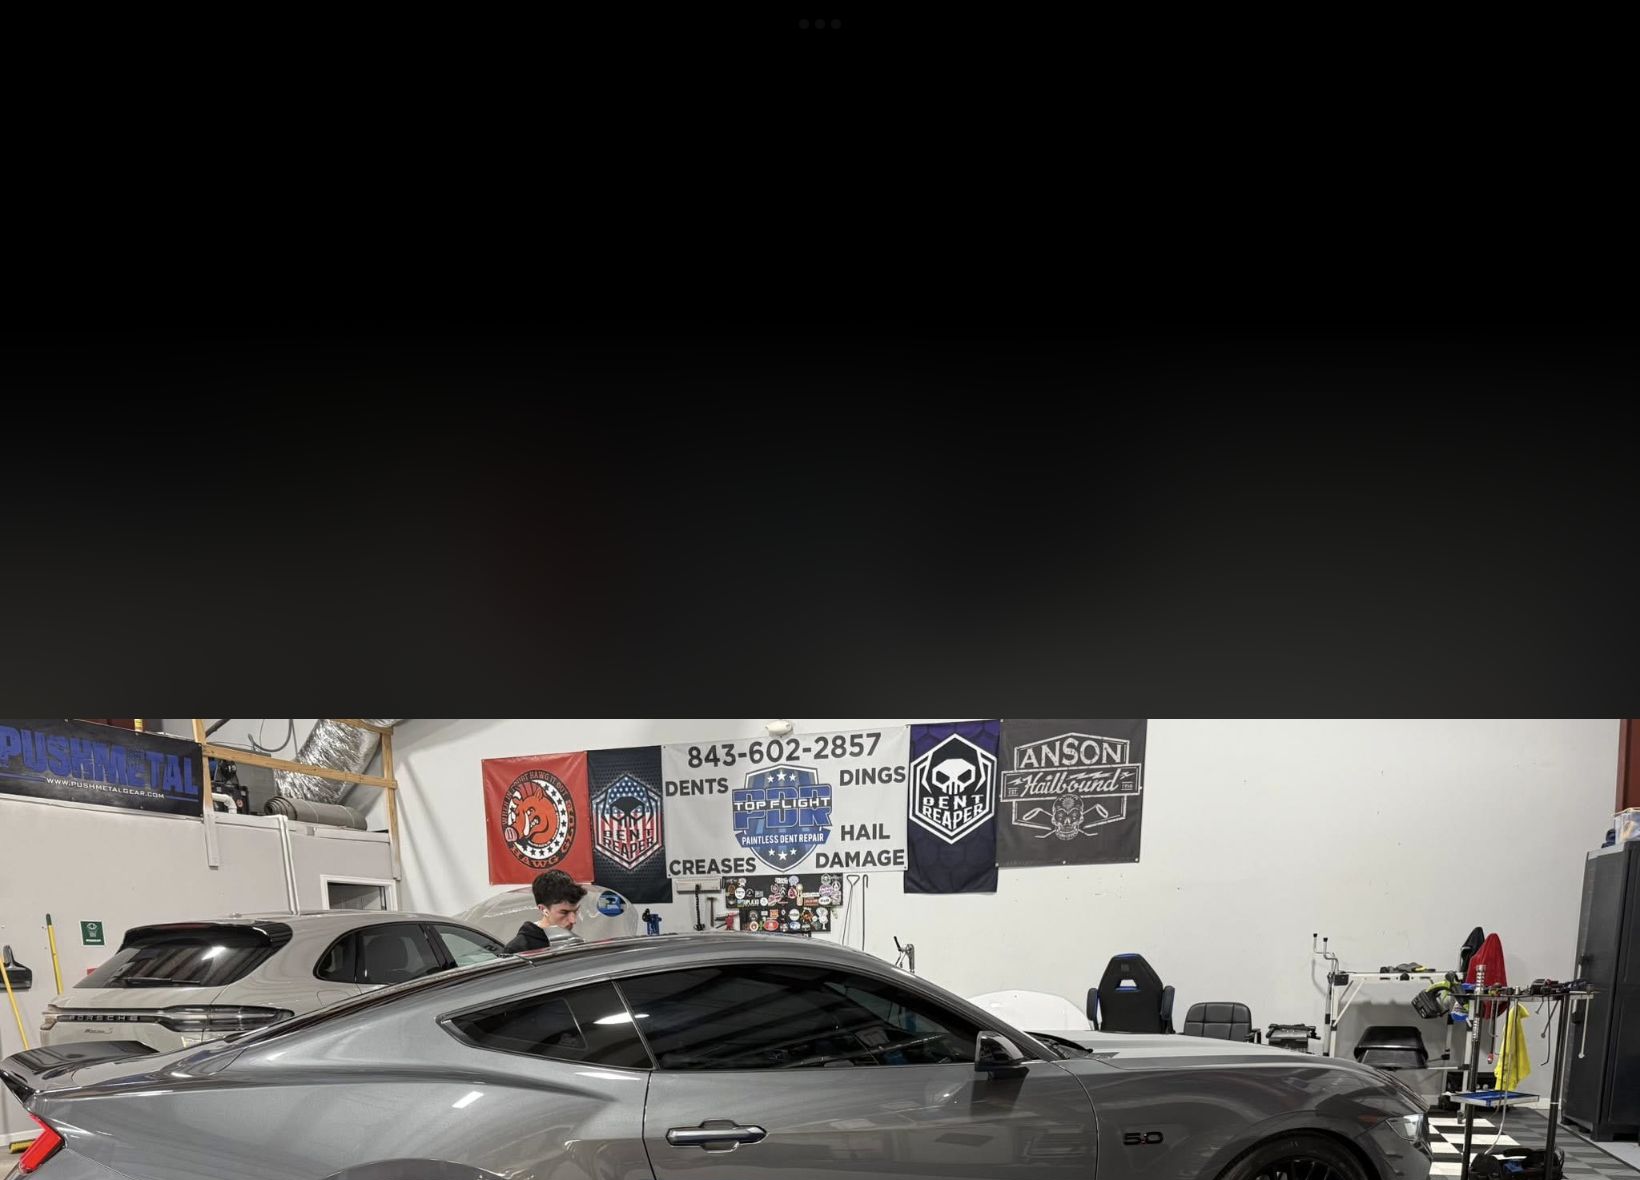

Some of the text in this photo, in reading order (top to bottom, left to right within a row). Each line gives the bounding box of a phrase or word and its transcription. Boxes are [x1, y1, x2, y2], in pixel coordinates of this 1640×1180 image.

[0, 725, 199, 795] PUSHMETAL
[688, 732, 882, 768] 843-602-2857
[1020, 737, 1121, 768] ANSON
[839, 766, 906, 786] DINGS
[1020, 768, 1121, 797] Hailbound
[46, 778, 165, 799] WWW.PUSHMETALGEAR.COM
[665, 778, 729, 797] DENTS
[734, 798, 830, 810] TOP FLIGHT
[922, 803, 983, 830] REAPER
[741, 833, 824, 845] PAINTLESS DENT REPAIR
[840, 823, 890, 841] HAIL
[603, 837, 653, 858] REAPER
[669, 857, 756, 876] CREASES
[815, 849, 905, 868] DAMAGE
